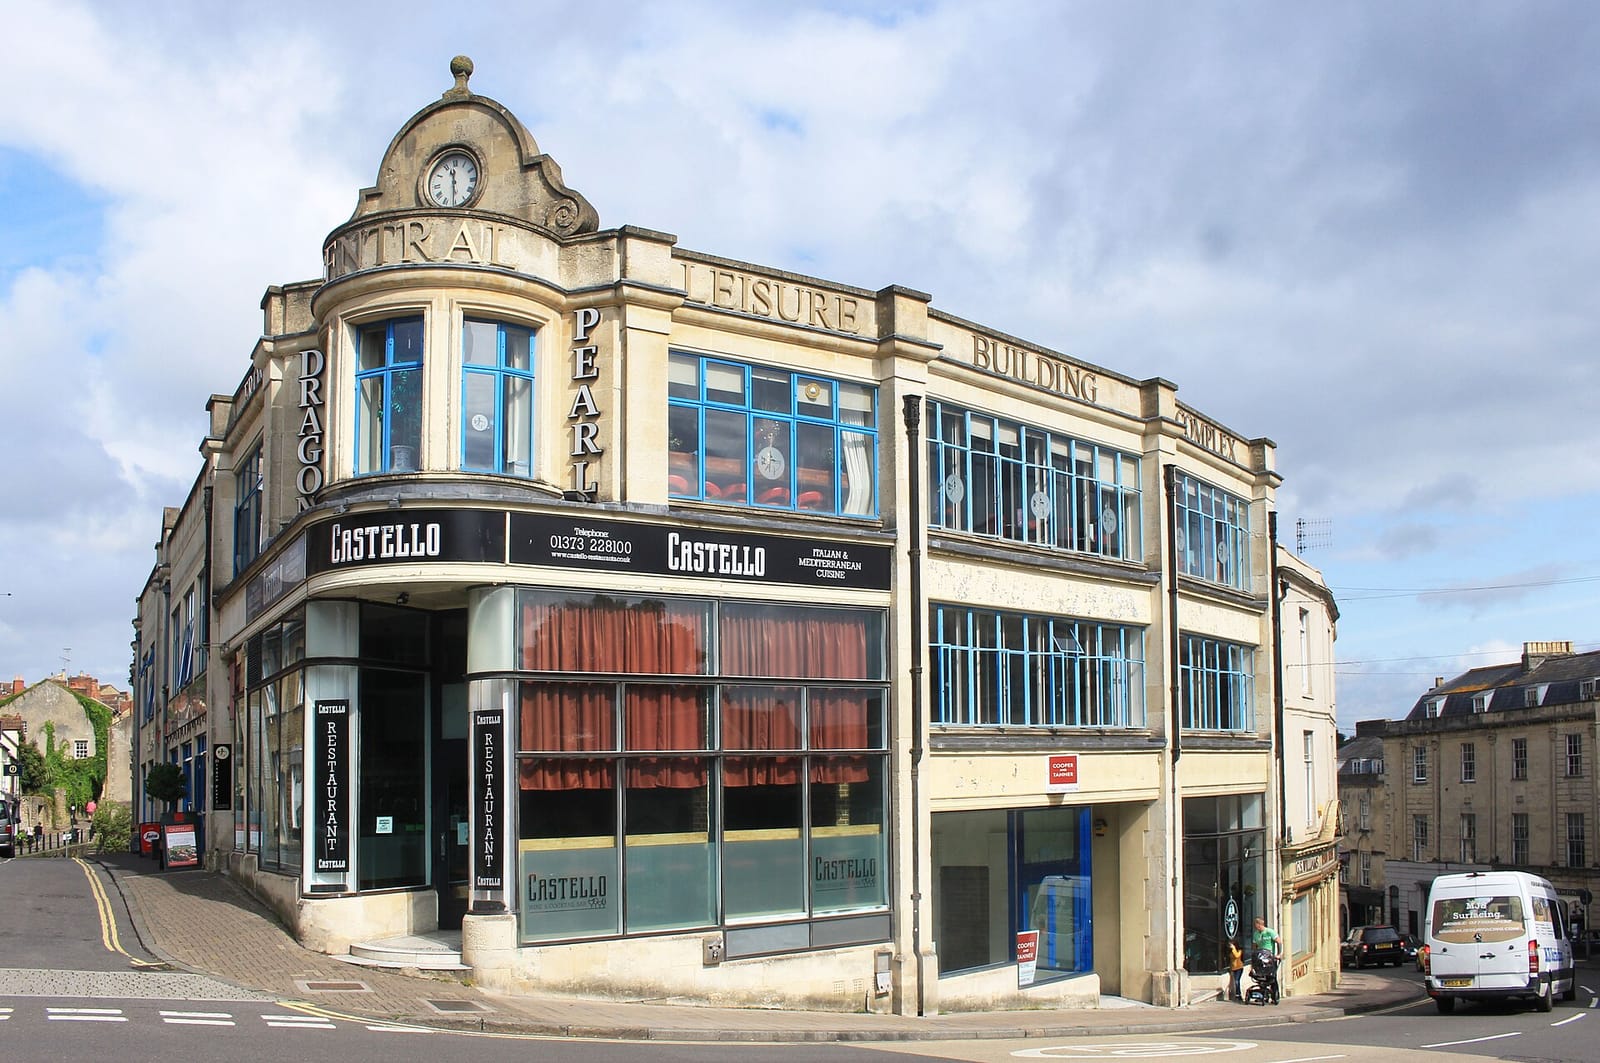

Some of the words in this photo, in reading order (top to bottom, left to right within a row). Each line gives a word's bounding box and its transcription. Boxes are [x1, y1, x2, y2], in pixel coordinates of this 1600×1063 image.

[681, 263, 860, 334] LEISURE
[971, 334, 1098, 403] BUILDING
[568, 307, 602, 495] PEARL
[331, 522, 441, 564] CASTELLO
[550, 535, 585, 551] 01373
[589, 538, 632, 554] 228100
[667, 532, 766, 577] CASTELLO
[812, 548, 842, 559] ITALIAN
[842, 551, 849, 560] &
[798, 557, 862, 571] MEDITERRANEAN
[816, 569, 846, 579] CUISINE
[326, 721, 338, 851] RESTAURANT
[484, 733, 494, 868] RESTAURANT
[815, 856, 876, 881] CASTELLO
[528, 873, 607, 901] CASTELLO
[1017, 941, 1035, 949] COOPER
